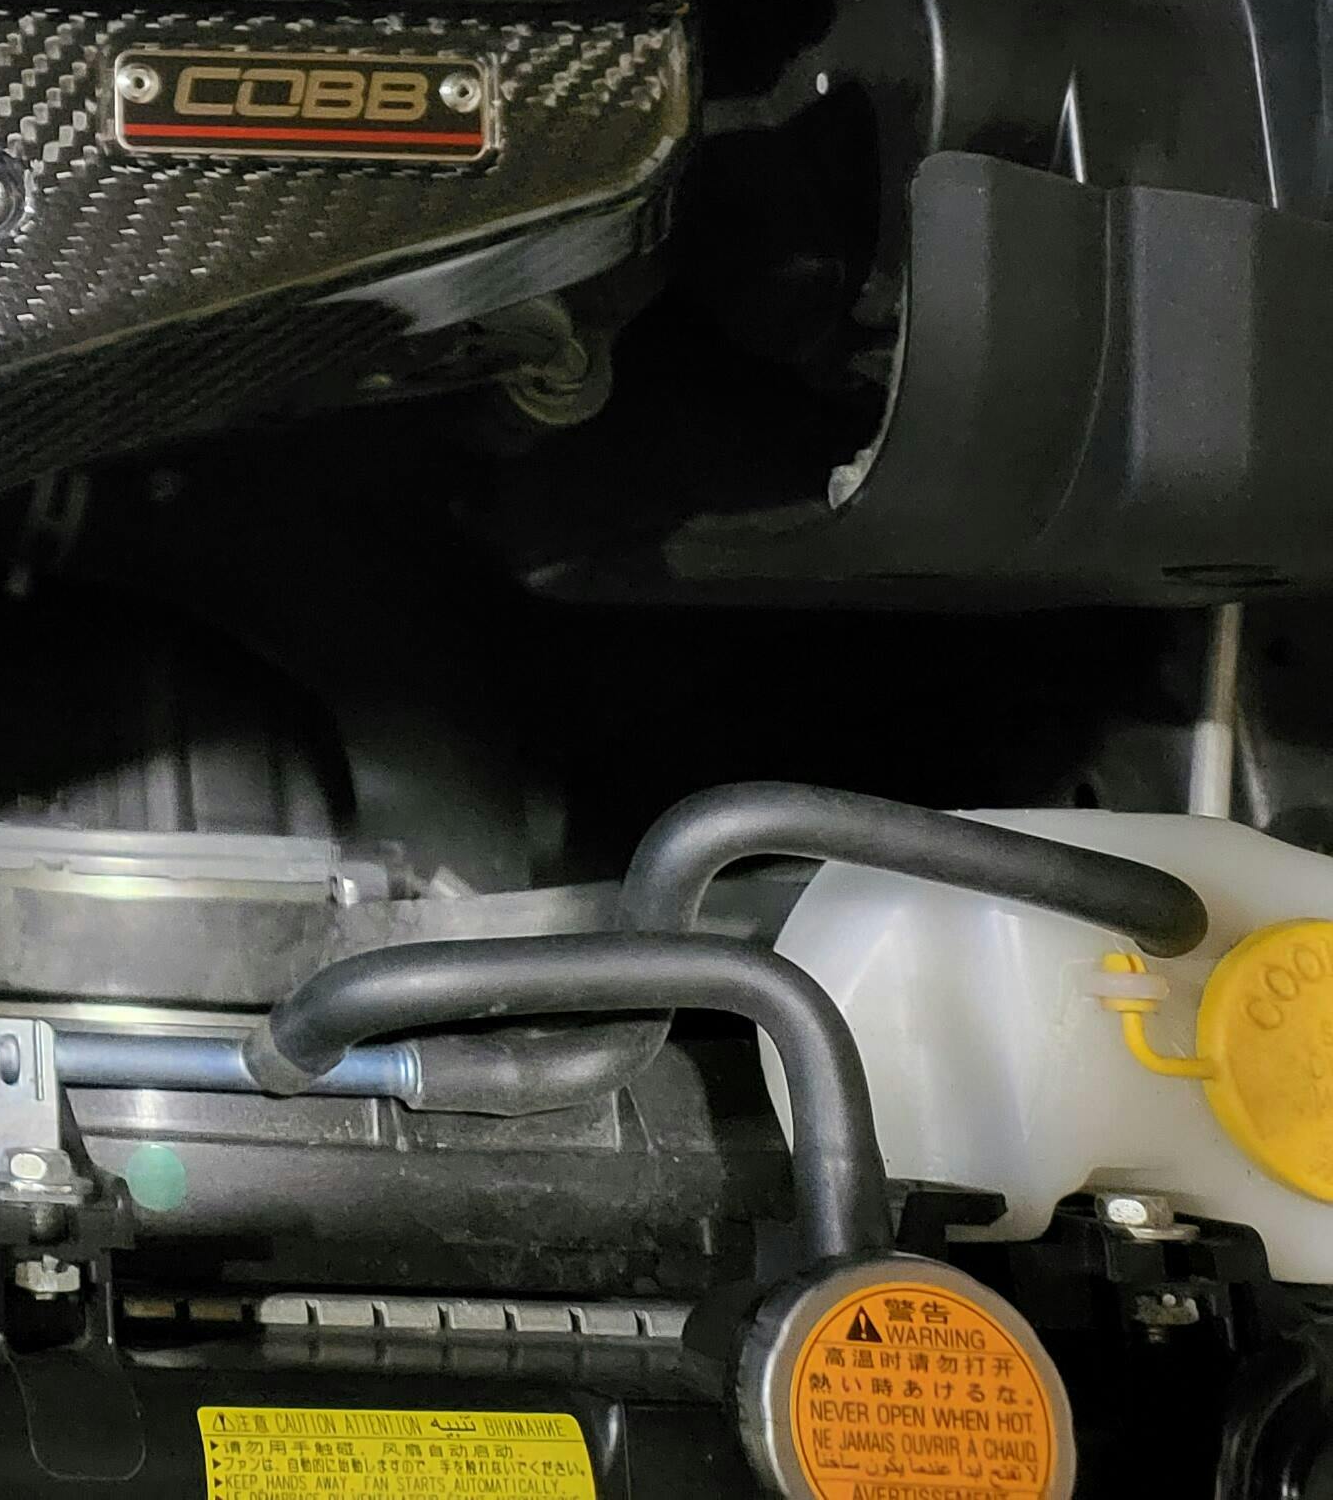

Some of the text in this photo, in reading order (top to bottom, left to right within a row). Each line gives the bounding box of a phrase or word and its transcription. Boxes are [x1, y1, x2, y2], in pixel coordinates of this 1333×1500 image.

[174, 66, 429, 121] COBB
[883, 1298, 952, 1326] 警告
[885, 1325, 985, 1350] WARNING
[824, 1347, 1015, 1378] 高温时请勿打开
[808, 1372, 1033, 1407] 熱い時あけるな。
[236, 1414, 270, 1433] 注意
[274, 1413, 337, 1435] CAUTION
[344, 1414, 423, 1436] ATTENTION
[485, 1418, 567, 1437] ВНИМАНИЕ
[809, 1399, 869, 1424] NEVER
[877, 1402, 926, 1428] OPEN
[934, 1406, 990, 1432] WHEN
[812, 1428, 831, 1450] NE
[839, 1430, 896, 1454] JAMAIS
[901, 1432, 961, 1458] OUVRIR
[966, 1432, 979, 1459] À
[225, 1474, 566, 1495] KEEP HANDS AWAY. FAN STARTS AUTOMATICALLY.
